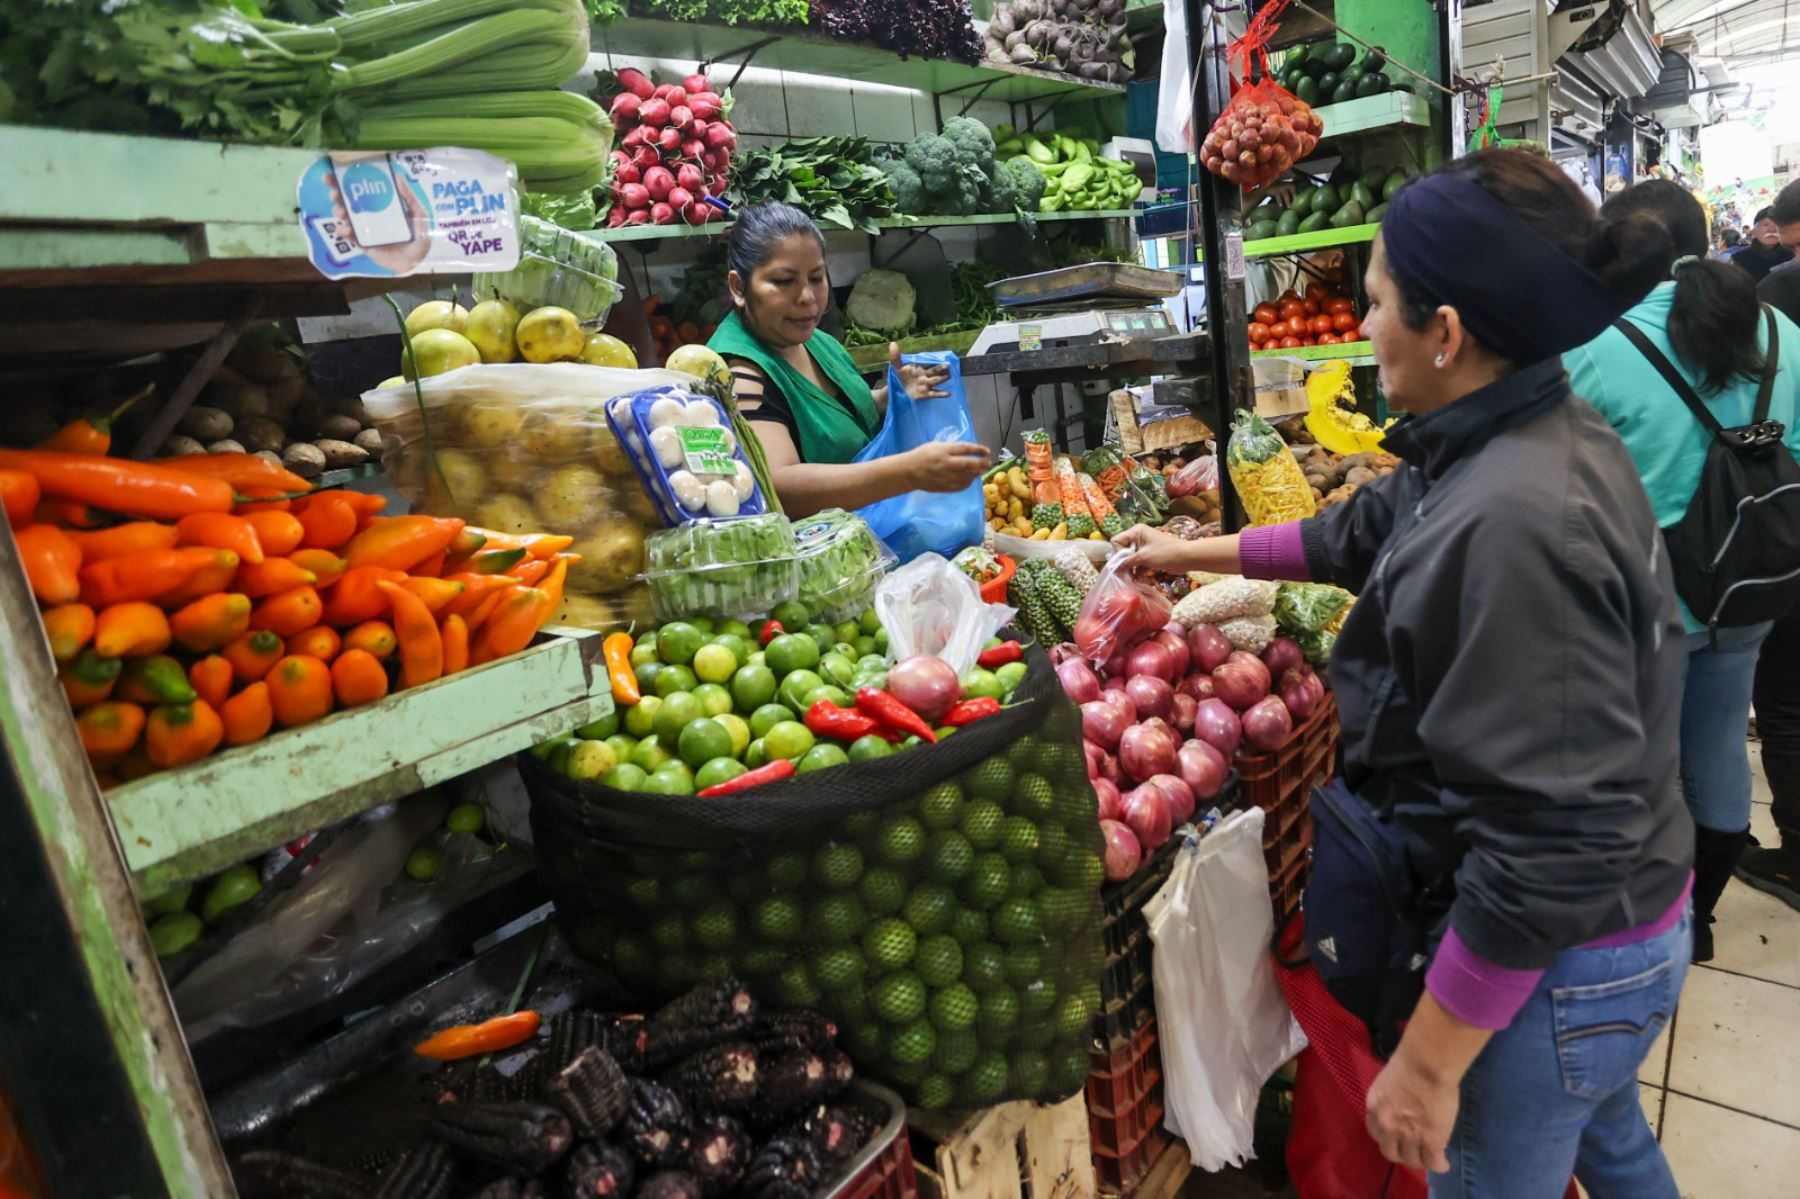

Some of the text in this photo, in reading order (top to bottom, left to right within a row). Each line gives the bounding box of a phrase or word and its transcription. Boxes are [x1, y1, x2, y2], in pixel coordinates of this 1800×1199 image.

[350, 178, 387, 201] plin
[433, 179, 483, 199] PAGA
[456, 192, 505, 216] PLIN
[448, 230, 467, 244] QR
[461, 238, 503, 256] YAPE
